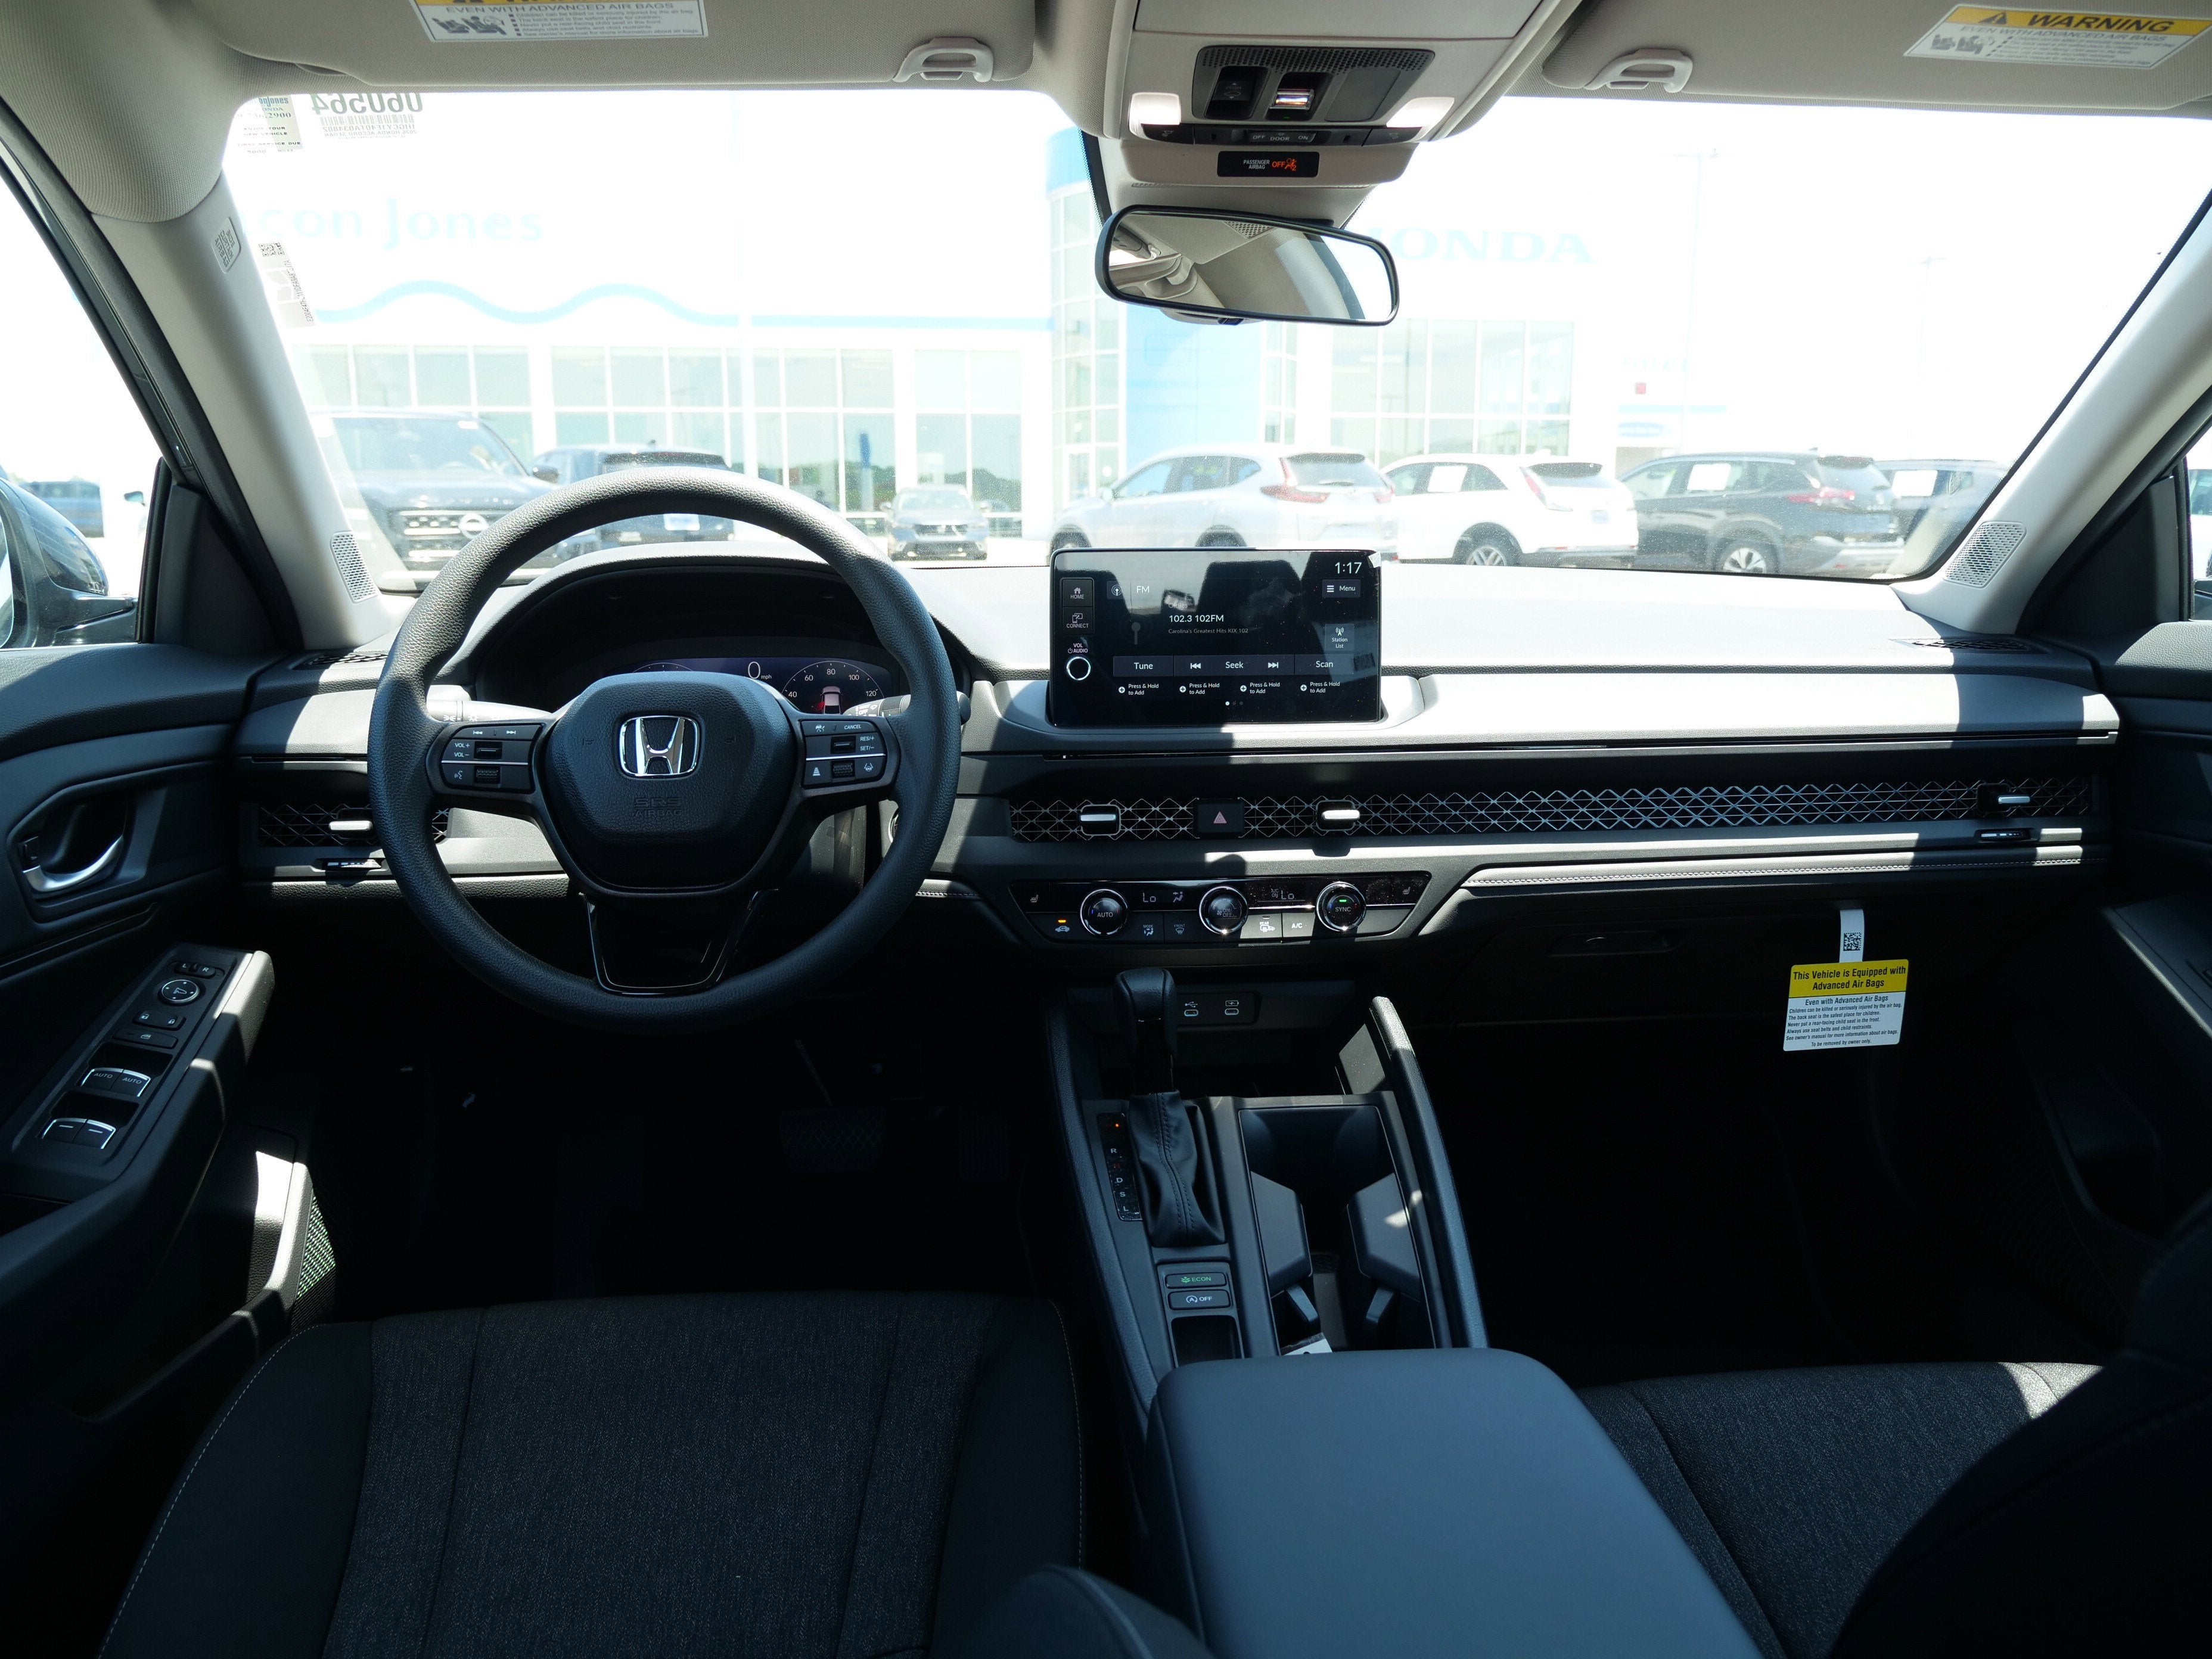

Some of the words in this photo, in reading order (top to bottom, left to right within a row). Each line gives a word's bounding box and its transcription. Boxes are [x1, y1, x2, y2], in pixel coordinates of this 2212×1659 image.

[2027, 14, 2175, 32] WARNING
[382, 197, 543, 251] Jones
[220, 229, 234, 260] CURTAIN
[226, 229, 235, 248] SIDE
[215, 238, 229, 268] AIRBAG
[1335, 562, 1362, 574] 1:17
[748, 661, 761, 679] 0
[634, 797, 681, 807] SRS
[1142, 892, 1157, 903] Lo
[1281, 890, 1295, 900] Lo
[1793, 971, 1809, 980] This
[1812, 970, 1840, 979] Vehicle
[1843, 969, 1850, 977] is
[1852, 967, 1887, 978] Equipped
[1890, 966, 1906, 974] with
[1812, 980, 1850, 990] Advanced
[1852, 980, 1863, 988] Air
[1866, 979, 1885, 989] Bags
